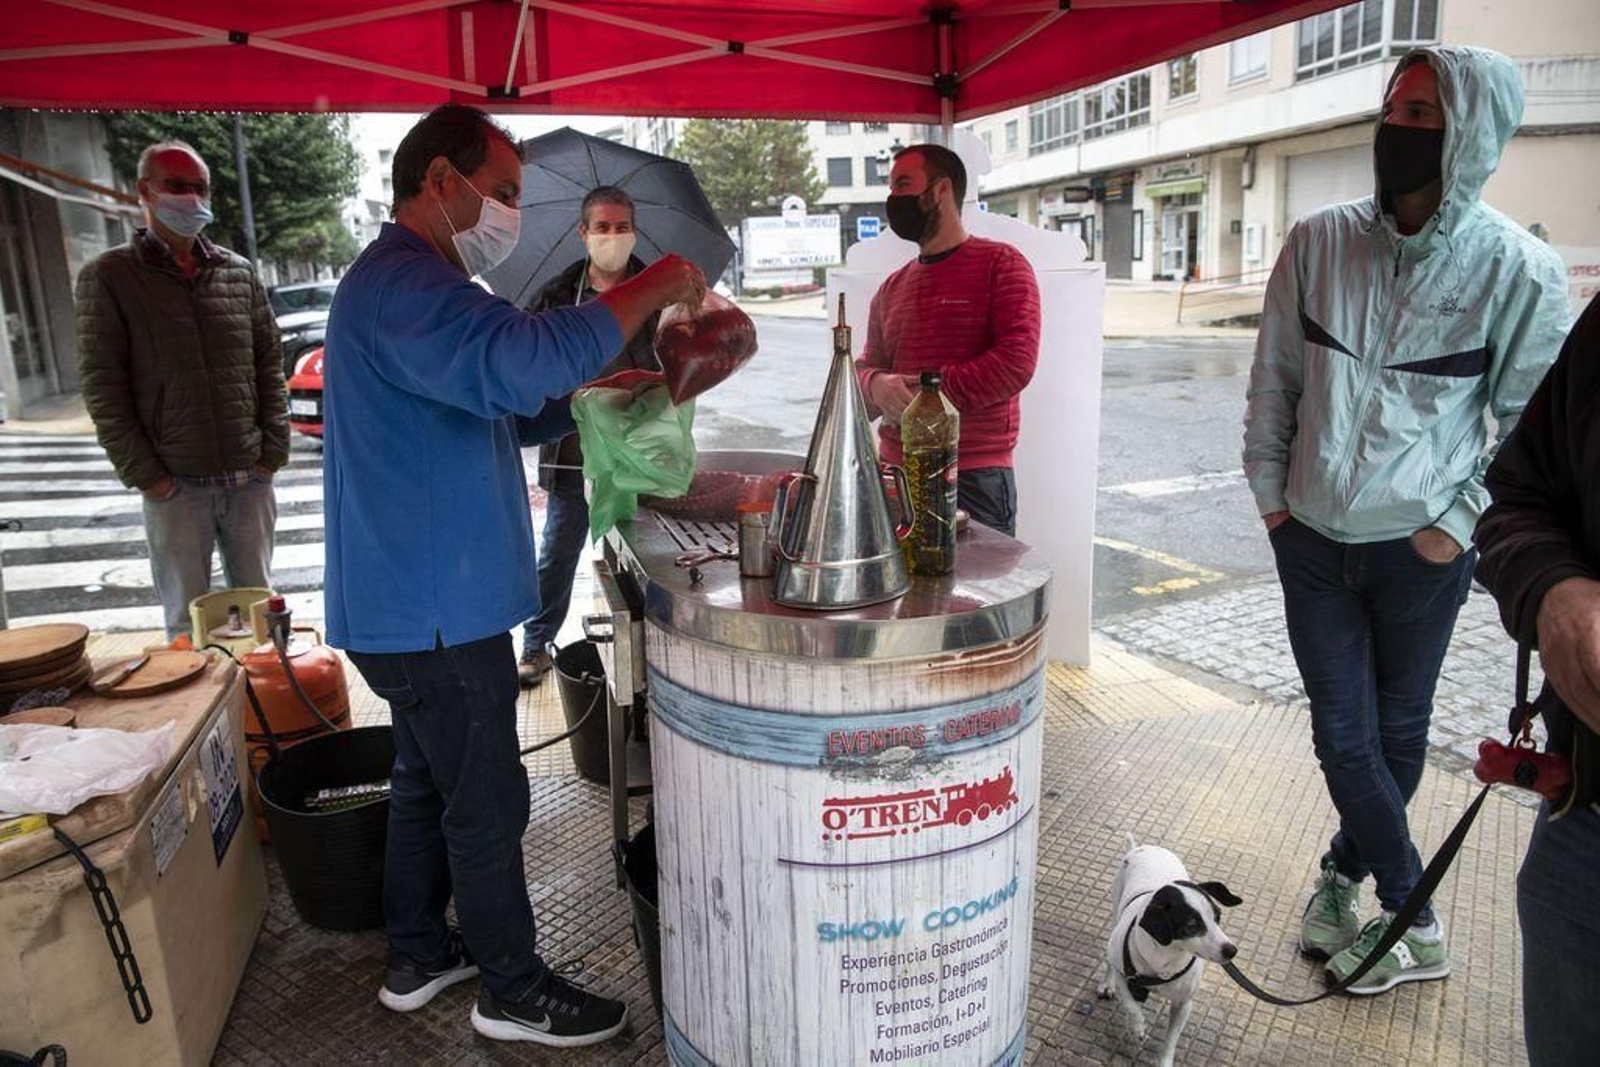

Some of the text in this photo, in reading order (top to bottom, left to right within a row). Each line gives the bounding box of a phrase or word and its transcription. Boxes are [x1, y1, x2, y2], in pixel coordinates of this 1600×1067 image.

[828, 724, 926, 757] EVENTOS
[822, 797, 942, 831] O'TREN
[817, 875, 1019, 943] SHOW COOKING
[841, 917, 1009, 972] Experiencia Gastronómica
[839, 970, 939, 995] Promociones,
[875, 975, 988, 1017] Eventos, Catering
[869, 1016, 990, 1064] Mobiliario Especial
[876, 1011, 953, 1040] Formación,
